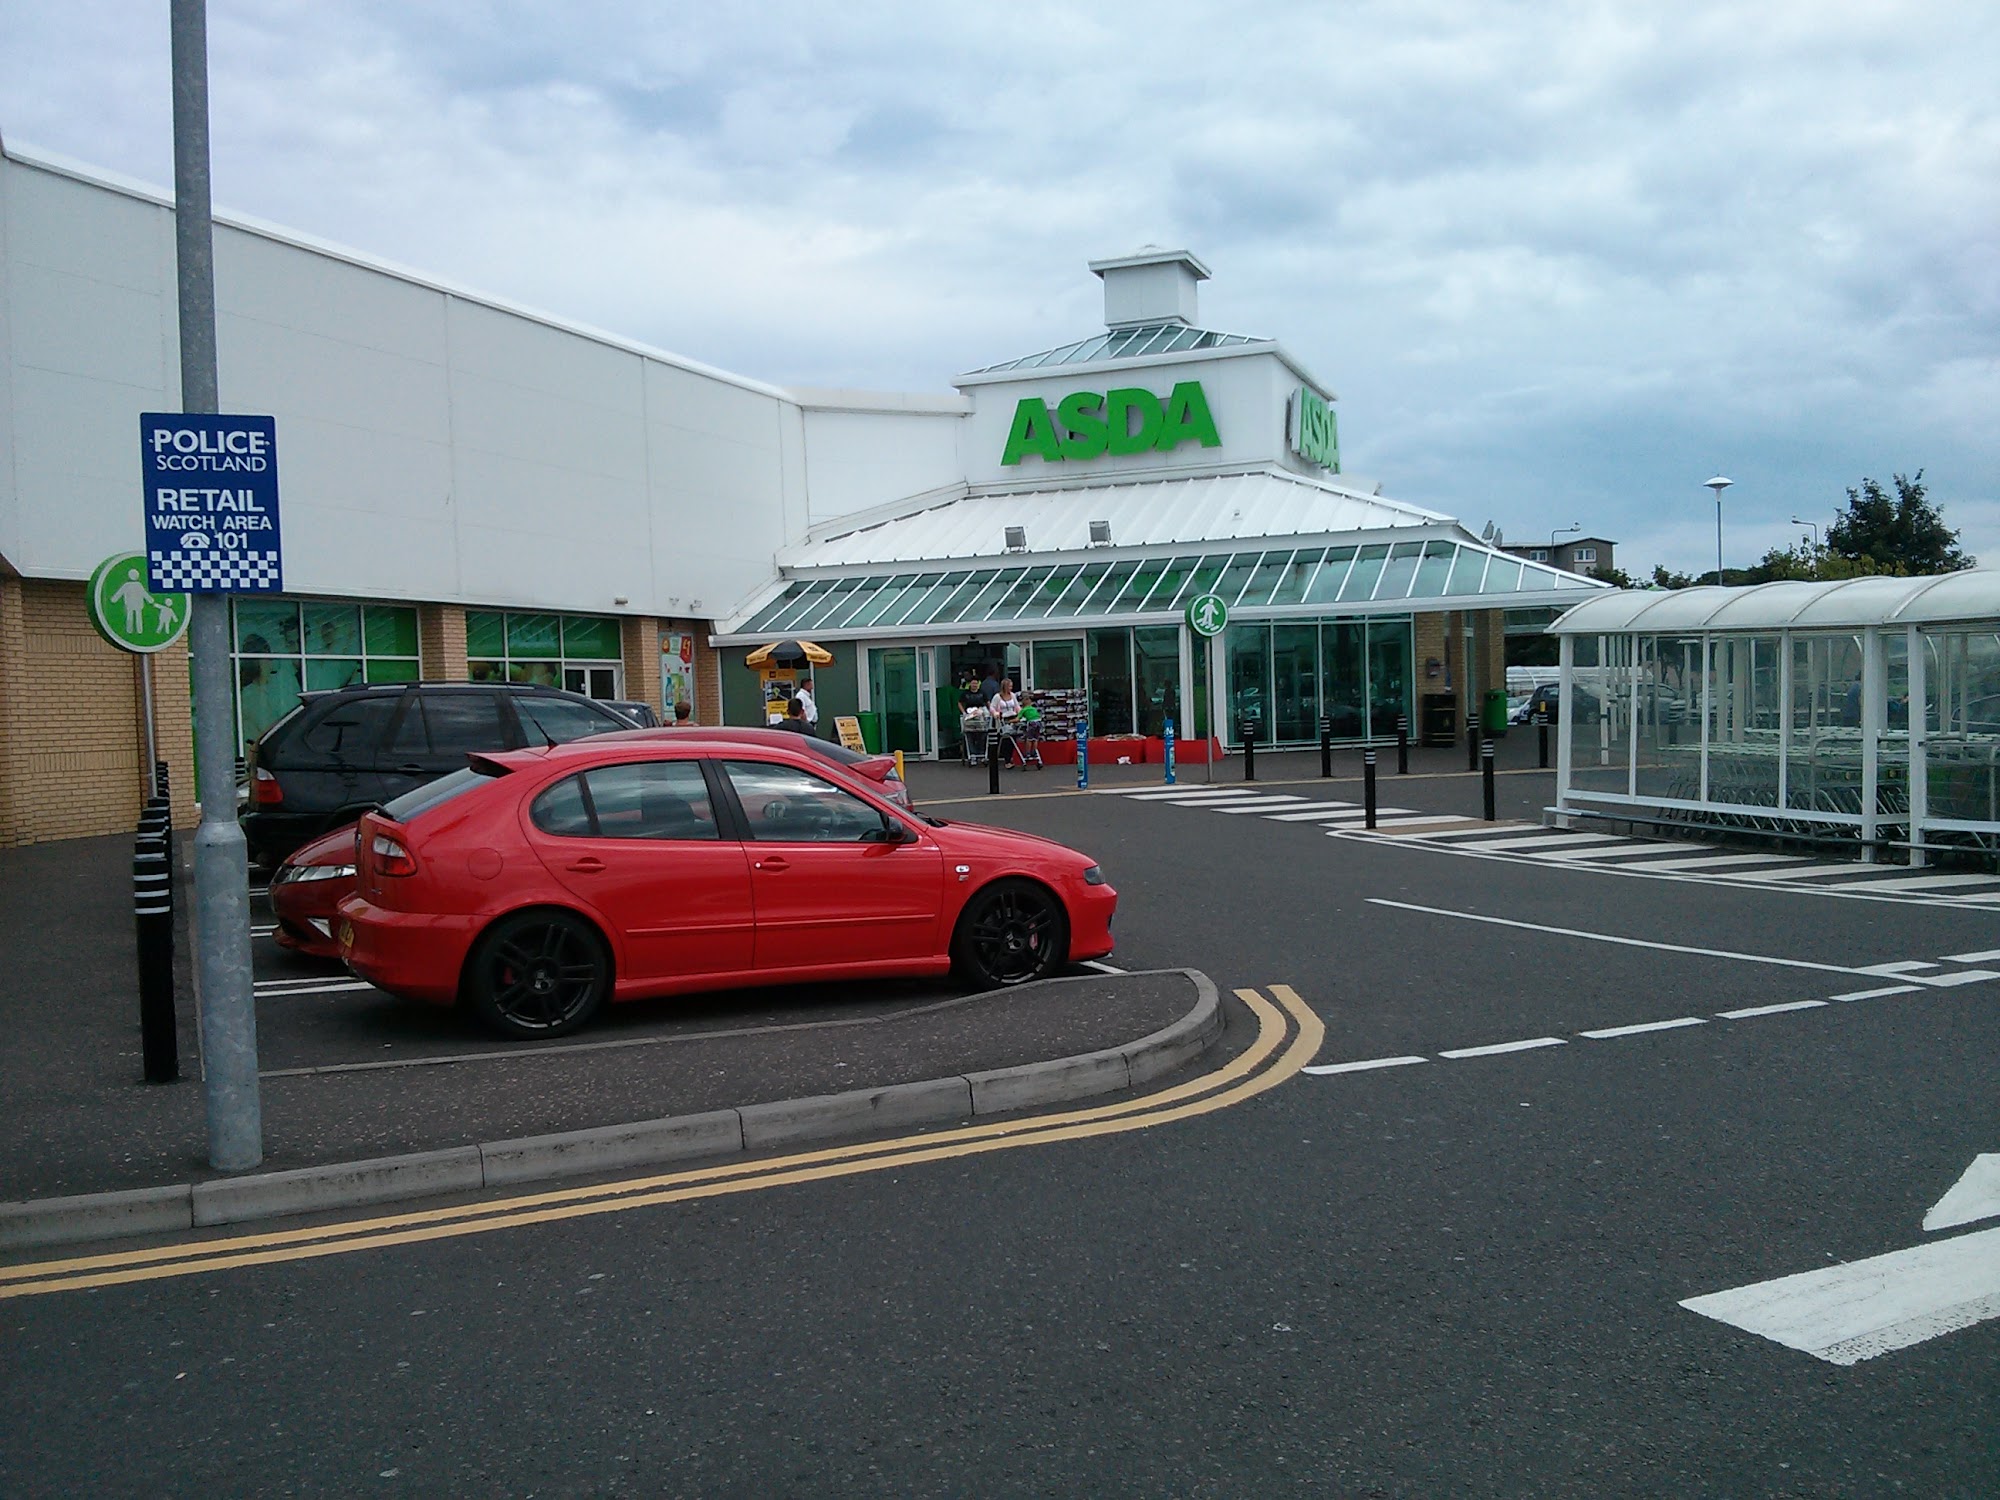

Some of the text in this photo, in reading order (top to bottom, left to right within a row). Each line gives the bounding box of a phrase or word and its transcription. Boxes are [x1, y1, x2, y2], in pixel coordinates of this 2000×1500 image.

[1001, 381, 1222, 465] ASDA
[1300, 386, 1341, 475] ASDA
[154, 429, 266, 454] POLICE
[157, 455, 267, 472] SCOTLAND
[157, 488, 265, 512] RETAIL
[152, 515, 273, 530] WATCH AREA
[214, 532, 248, 549] 101
